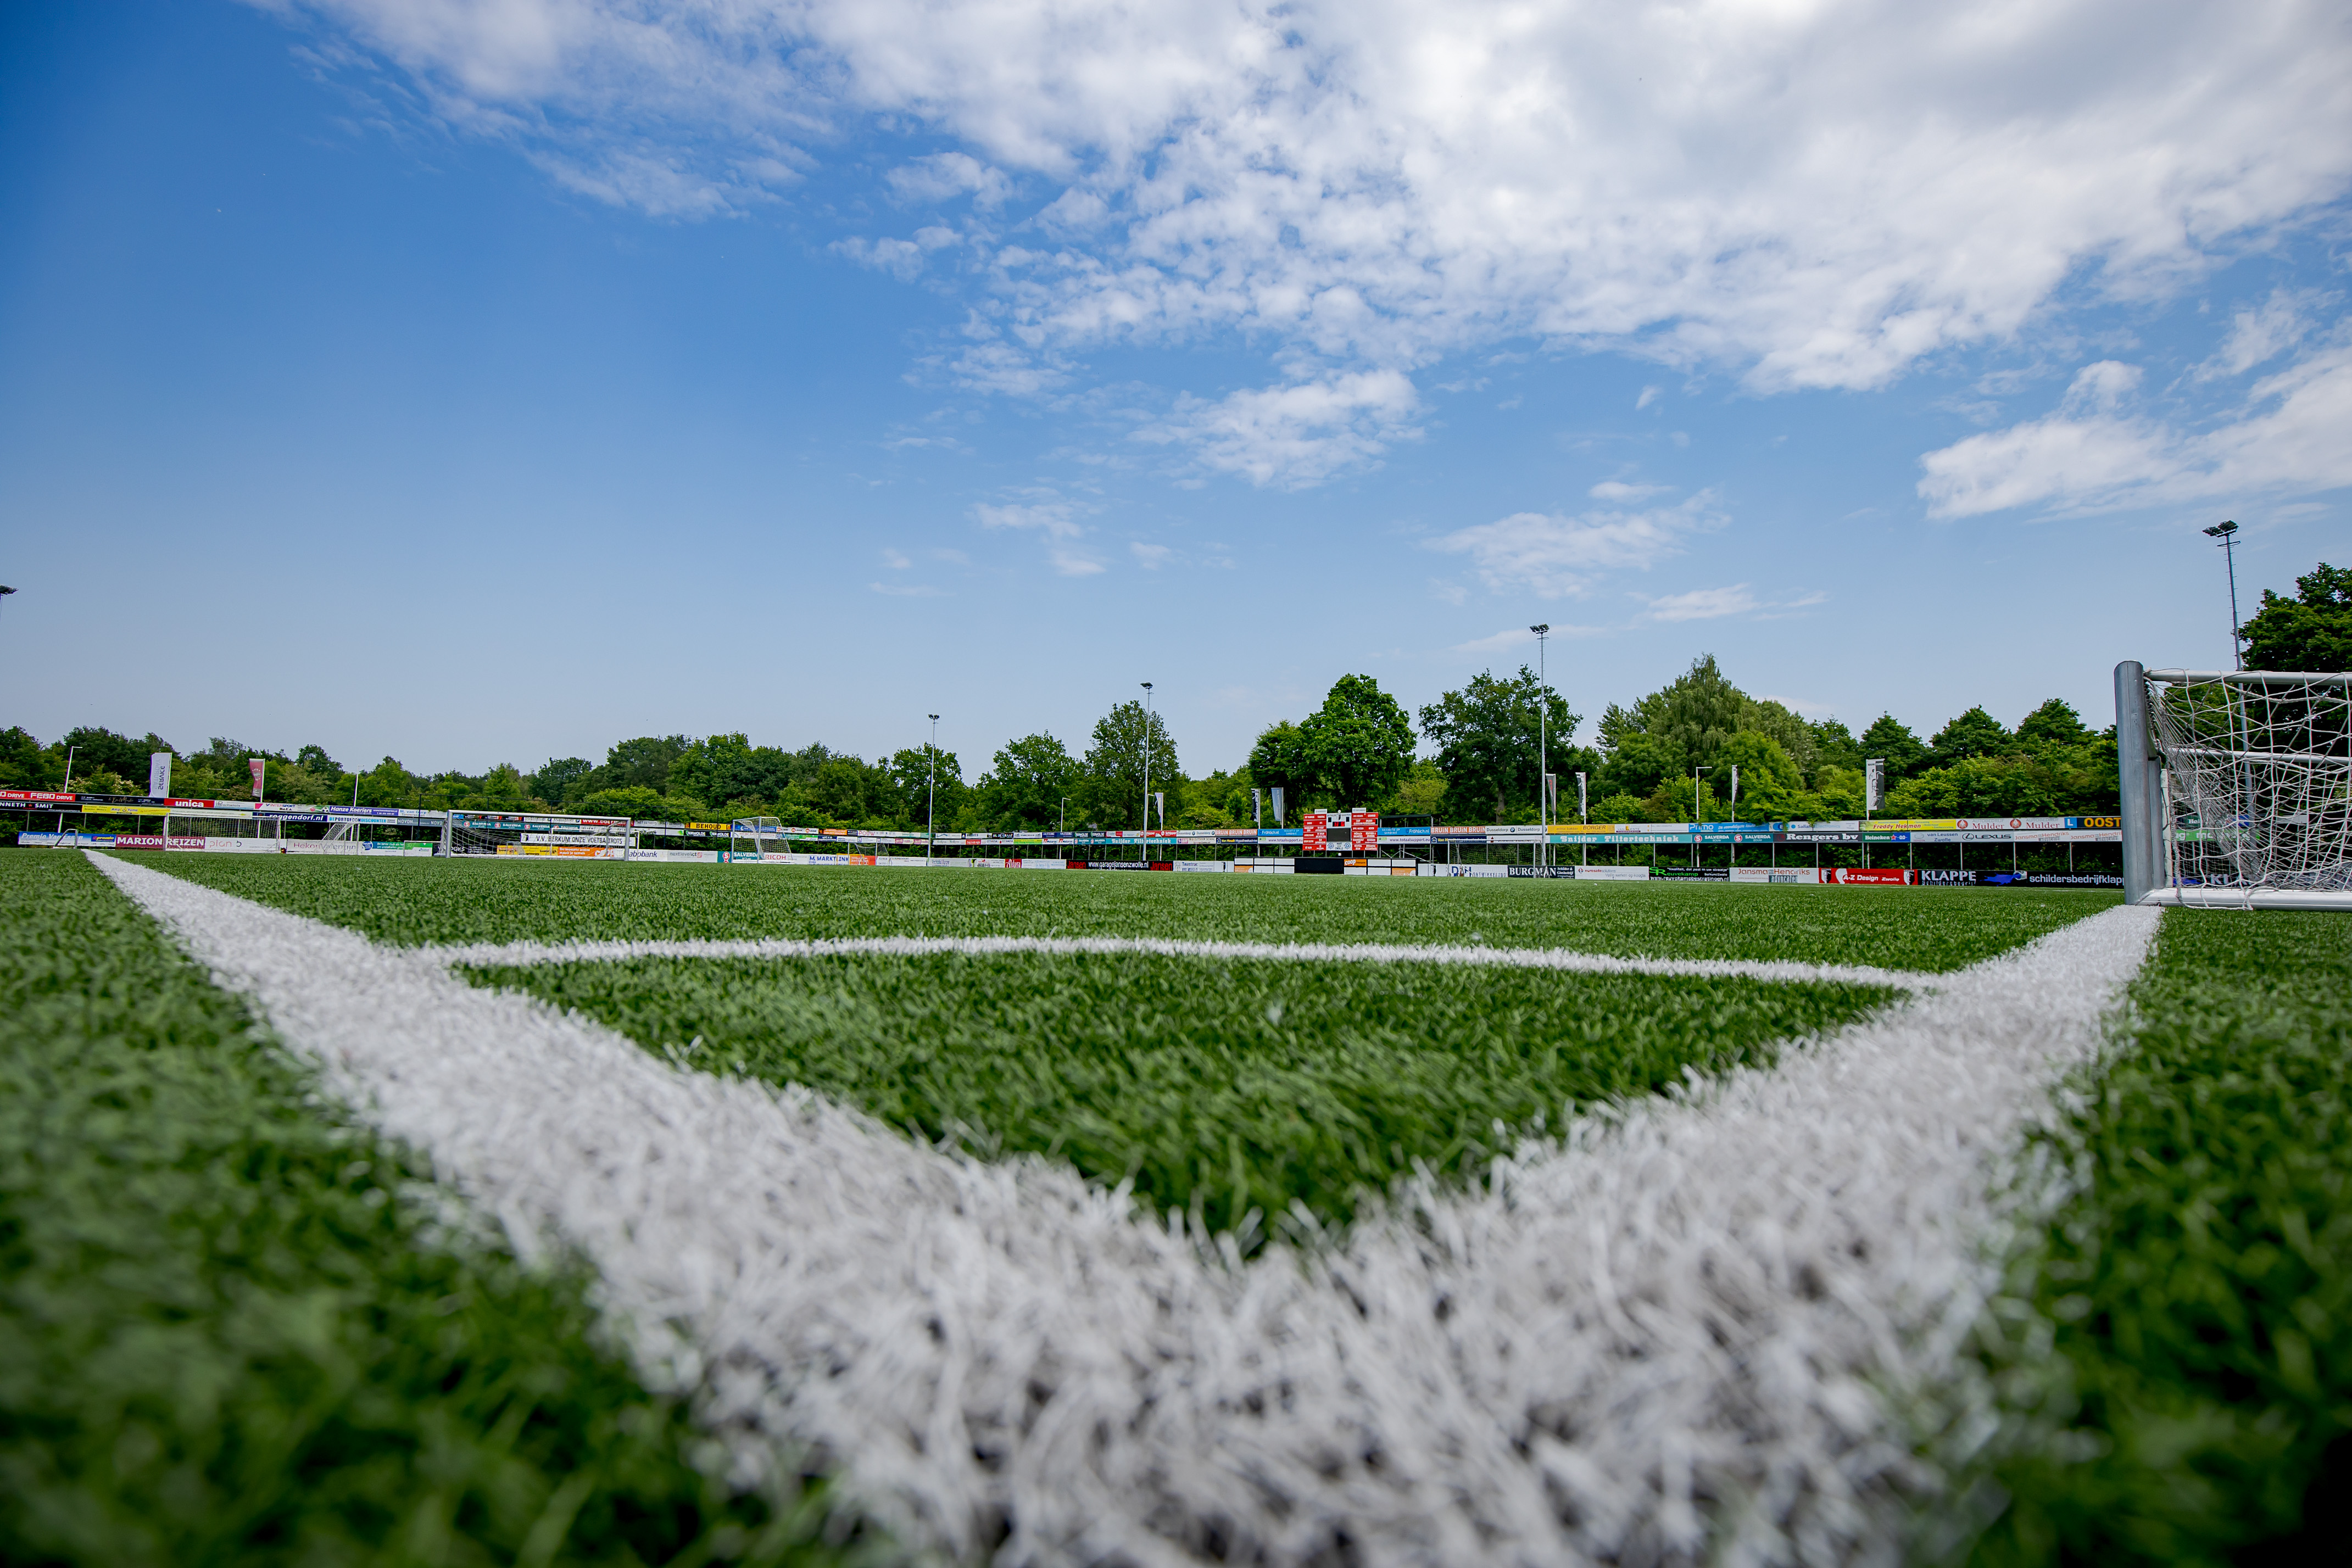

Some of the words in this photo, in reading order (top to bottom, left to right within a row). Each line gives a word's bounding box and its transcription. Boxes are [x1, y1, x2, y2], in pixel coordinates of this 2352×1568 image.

[2084, 817, 2121, 827] OOST
[117, 837, 163, 845] MARION
[210, 840, 232, 848] plan
[1067, 861, 1086, 869] Jansen
[1088, 861, 1149, 870] www.garagejansenzwolle.nl
[1150, 861, 1173, 871] Jansen
[1509, 867, 1556, 876] BURGMAN
[1921, 871, 1976, 881] KLAPPE
